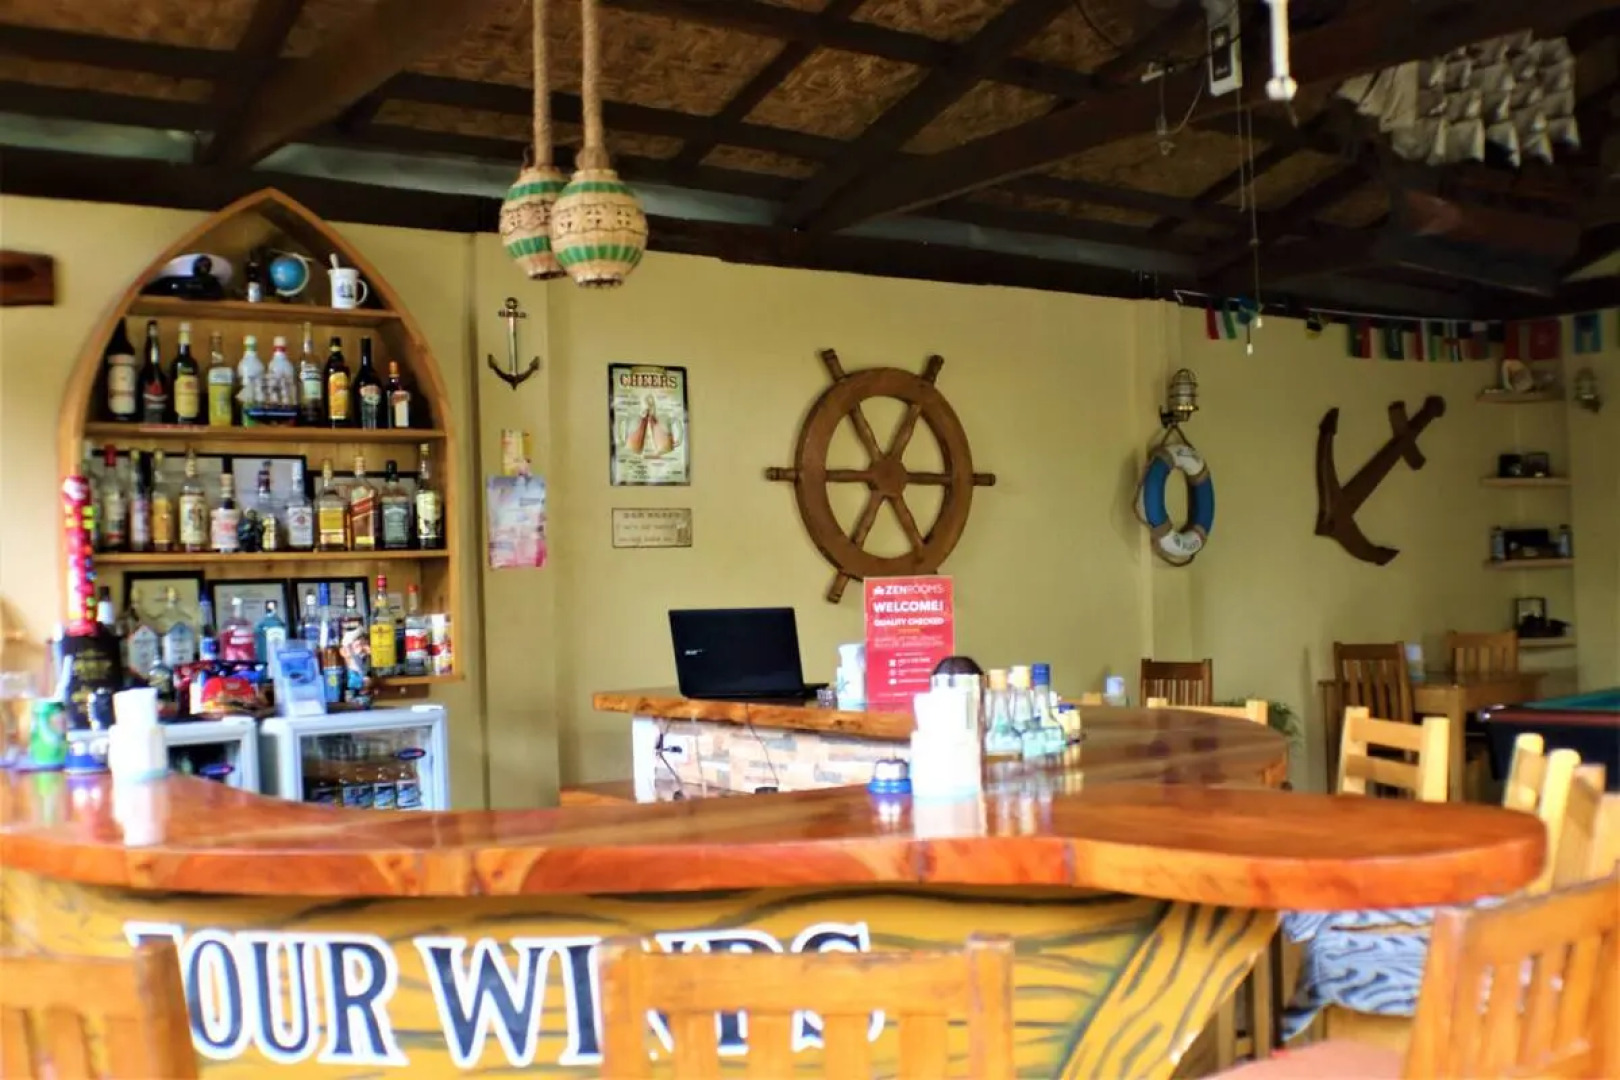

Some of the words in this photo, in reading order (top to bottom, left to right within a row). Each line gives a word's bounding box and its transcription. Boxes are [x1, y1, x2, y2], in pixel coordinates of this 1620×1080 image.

[620, 373, 678, 389] CHEERS
[873, 600, 943, 613] WELCOME!
[122, 920, 410, 1067] OUR
